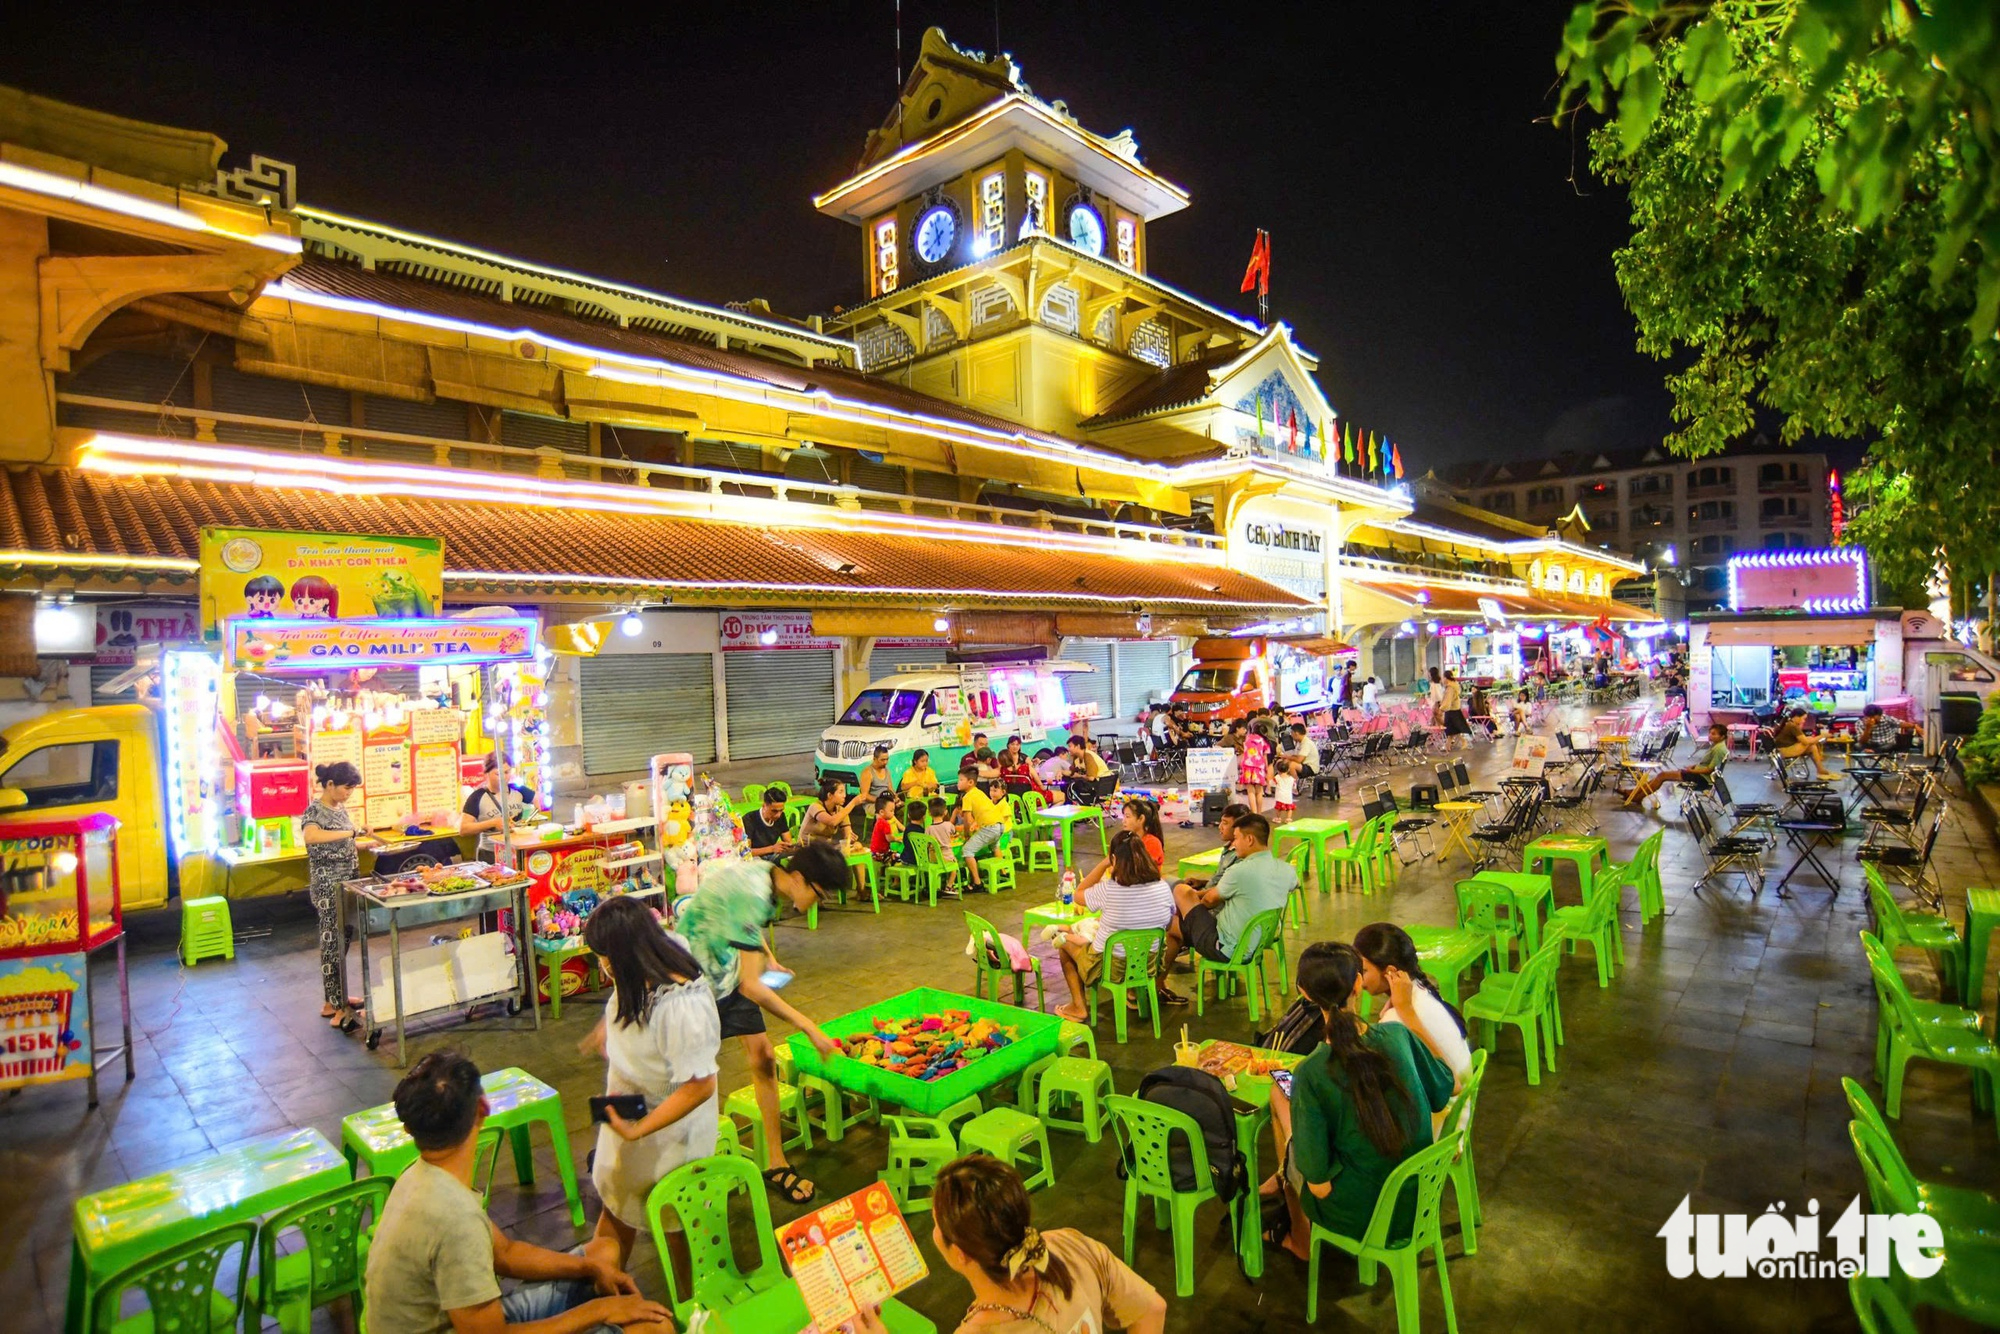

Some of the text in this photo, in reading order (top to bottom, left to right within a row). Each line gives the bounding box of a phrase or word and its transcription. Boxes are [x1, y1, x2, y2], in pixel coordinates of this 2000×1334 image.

[1246, 522, 1321, 553] CHỢ BÌNH TÂY
[724, 622, 741, 634] 10
[432, 642, 472, 654] TEA
[652, 640, 662, 648] 09
[817, 1198, 853, 1223] MENU
